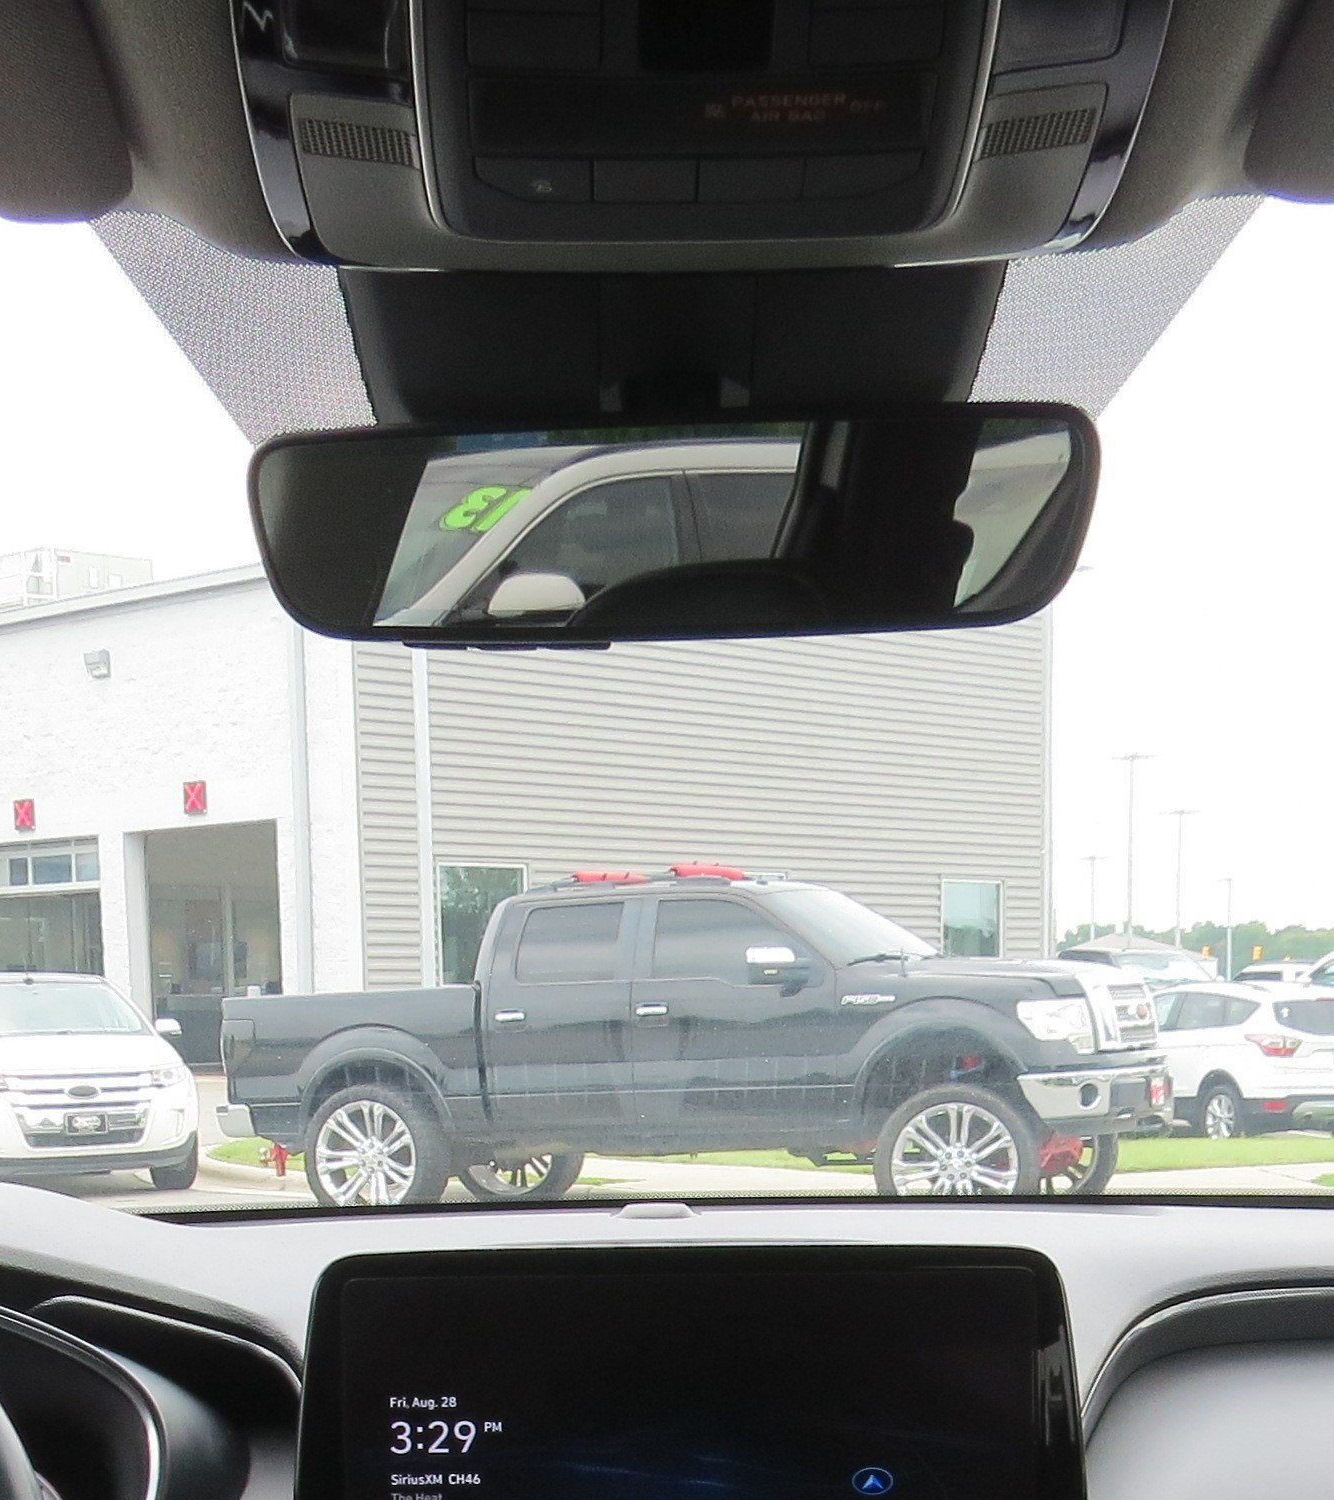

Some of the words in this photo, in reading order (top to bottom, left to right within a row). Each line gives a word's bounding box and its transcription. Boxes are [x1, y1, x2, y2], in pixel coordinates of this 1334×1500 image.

[730, 92, 847, 108] PASSENGER
[750, 110, 781, 122] AIR
[787, 109, 826, 122] BAG
[412, 1397, 438, 1410] Aug.
[441, 1396, 457, 1408] 28
[389, 1420, 477, 1455] 3:29
[483, 1421, 503, 1433] PM
[390, 1474, 443, 1485] SiriusXM
[448, 1473, 481, 1485] CH46
